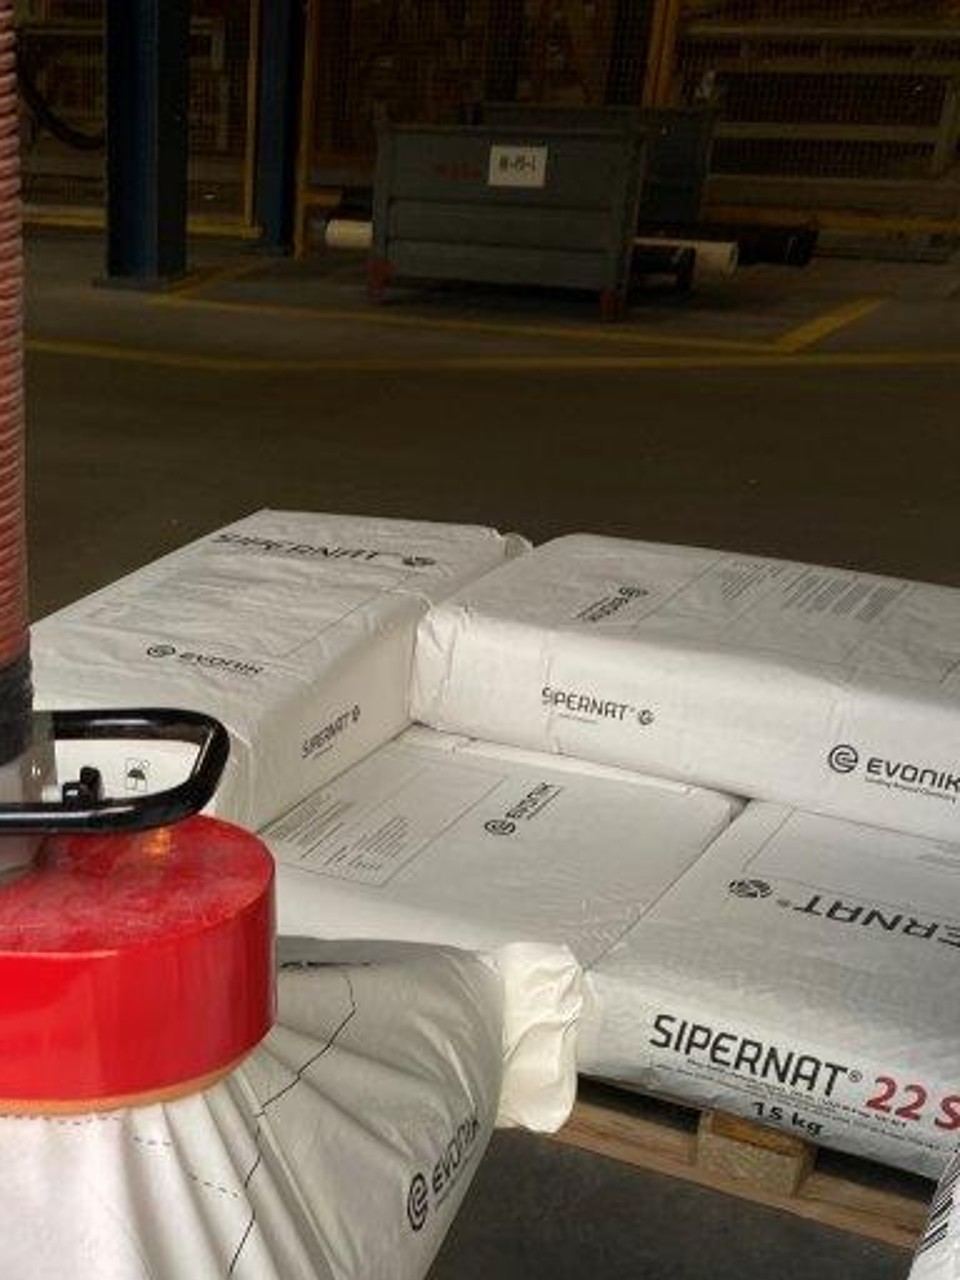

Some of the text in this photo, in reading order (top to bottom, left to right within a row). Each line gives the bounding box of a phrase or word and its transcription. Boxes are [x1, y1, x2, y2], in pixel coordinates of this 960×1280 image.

[867, 757, 960, 792] EVONIK
[866, 1076, 927, 1121] 22
[753, 1102, 825, 1136] 15 kg
